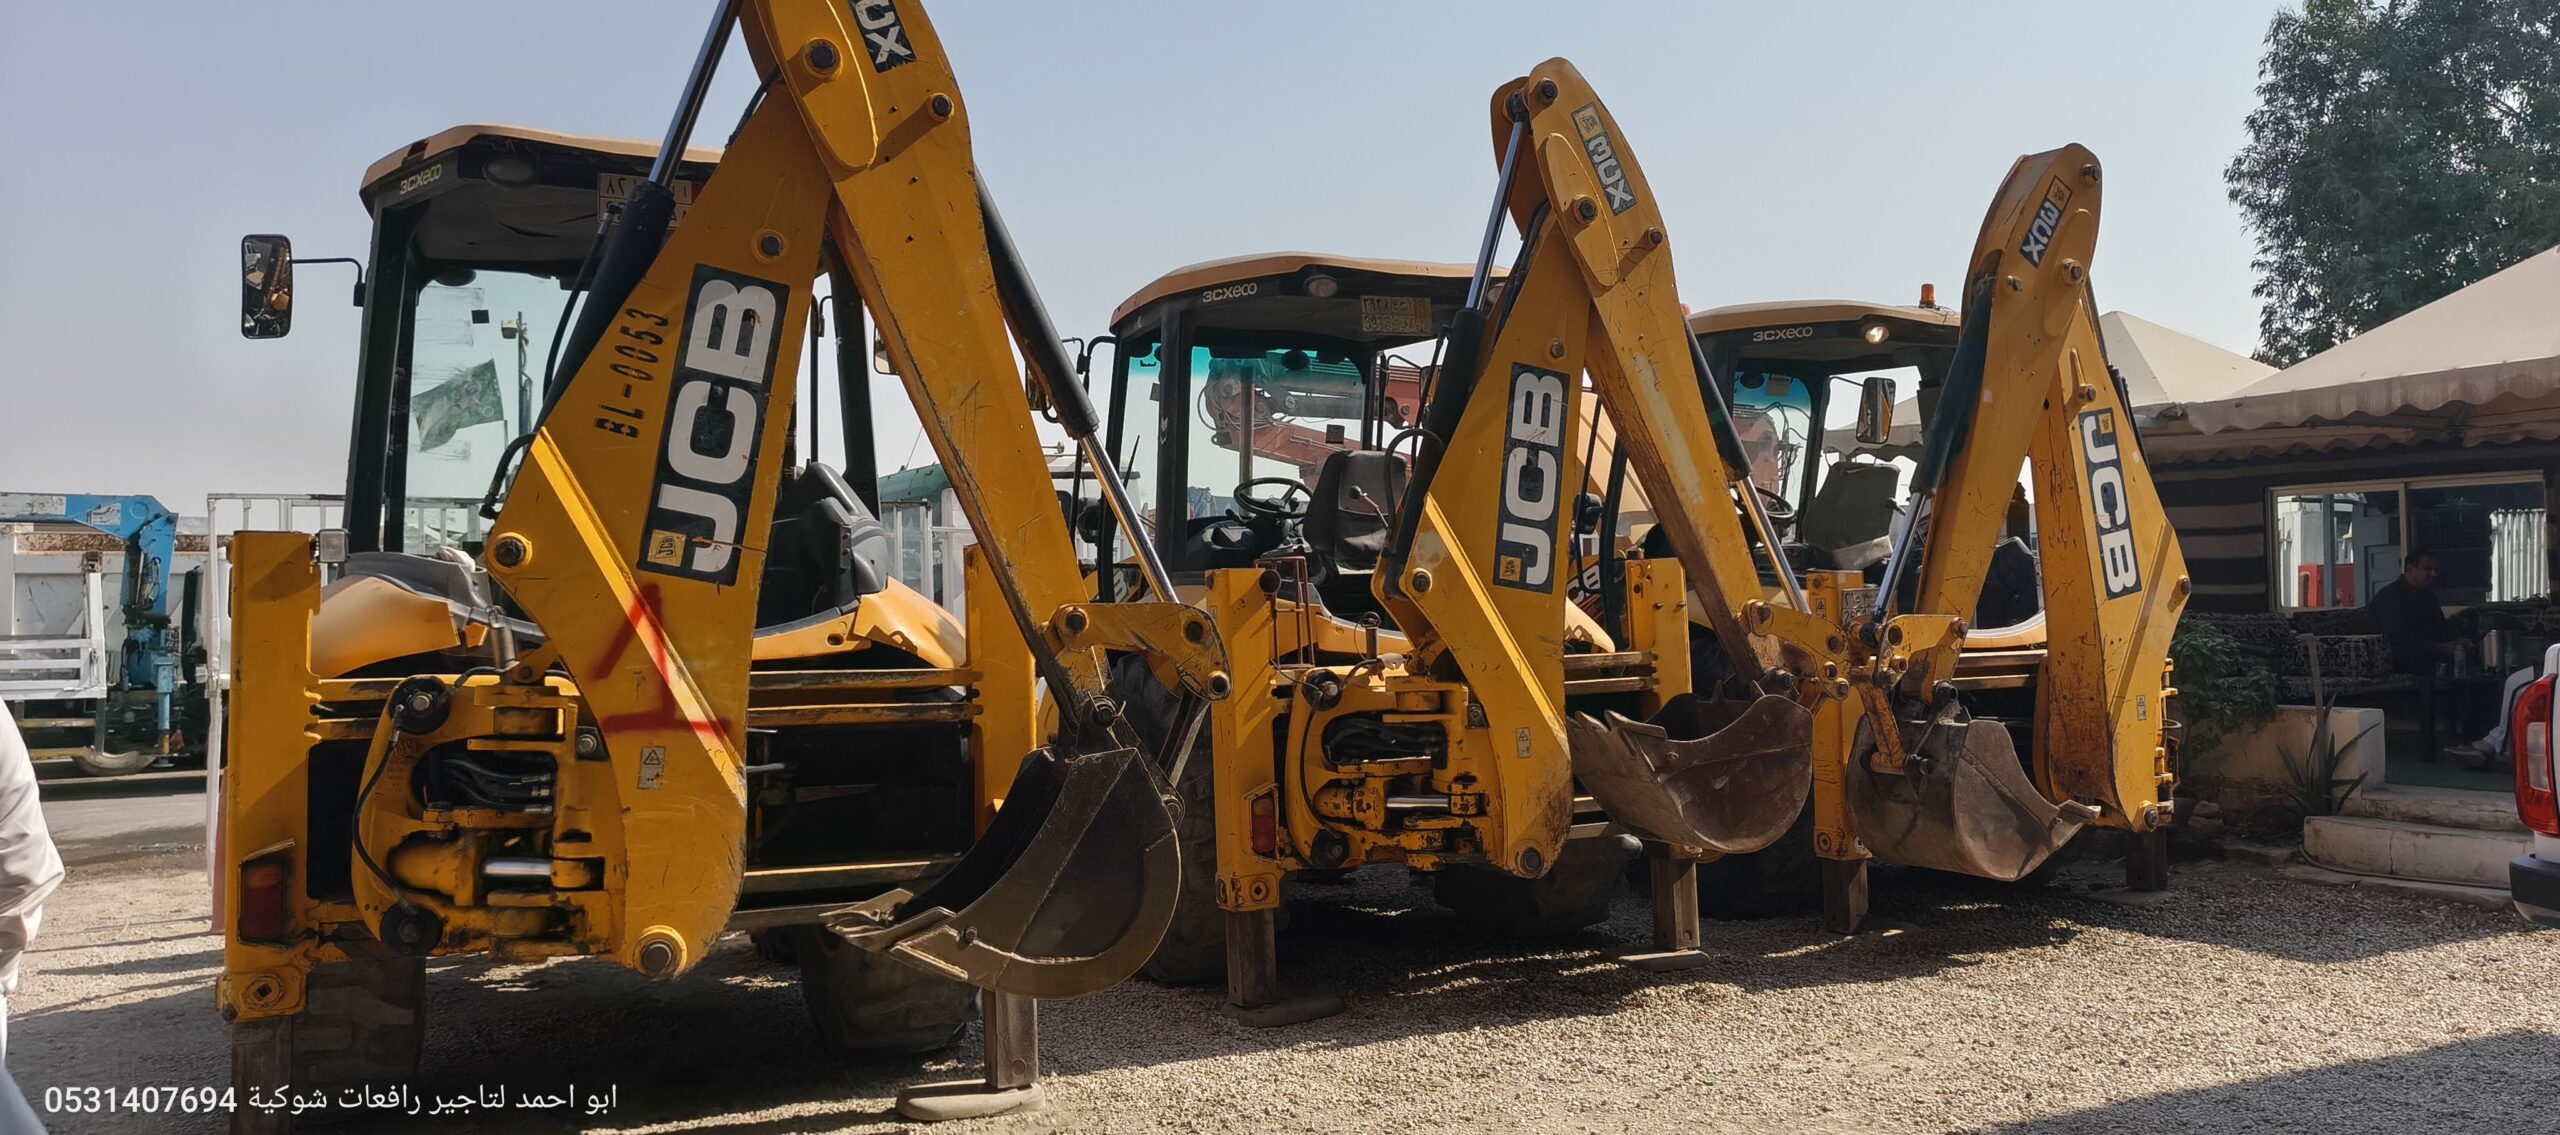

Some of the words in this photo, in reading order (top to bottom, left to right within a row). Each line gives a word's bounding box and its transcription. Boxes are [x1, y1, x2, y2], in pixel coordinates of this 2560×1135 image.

[856, 0, 912, 63] CX
[1588, 135, 1633, 209] 3CX
[2022, 200, 2060, 264] 3CX
[1202, 283, 1257, 303] 3CXeco
[1753, 326, 1813, 342] 3CXeco
[592, 308, 670, 439] BL-0053
[657, 279, 777, 573] JCB
[1502, 372, 1563, 585] JCB
[2083, 415, 2137, 593] JCB
[1566, 565, 1600, 604] CB
